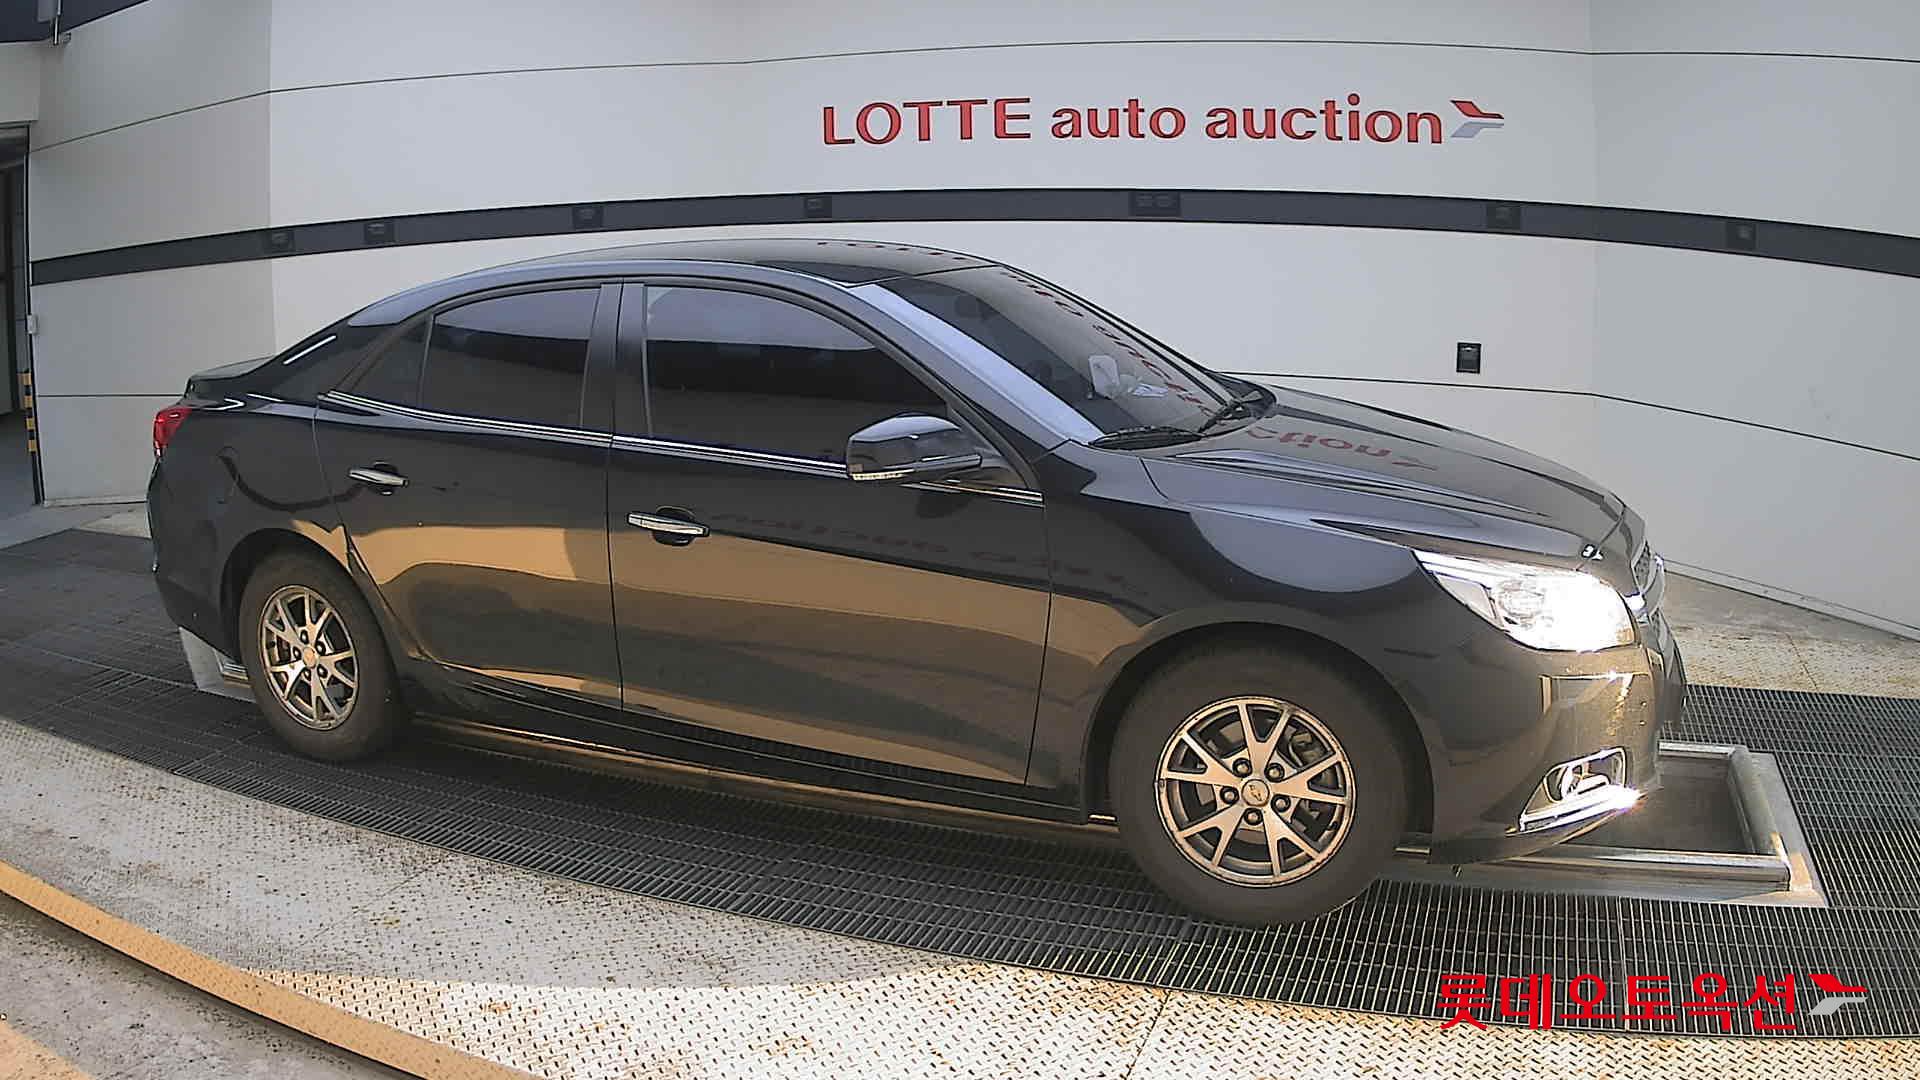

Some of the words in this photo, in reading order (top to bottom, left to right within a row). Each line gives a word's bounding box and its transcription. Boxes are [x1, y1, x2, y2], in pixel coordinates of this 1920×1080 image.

[823, 98, 1031, 145] LOTTE
[1051, 99, 1186, 140] auto
[1205, 93, 1443, 145] auction
